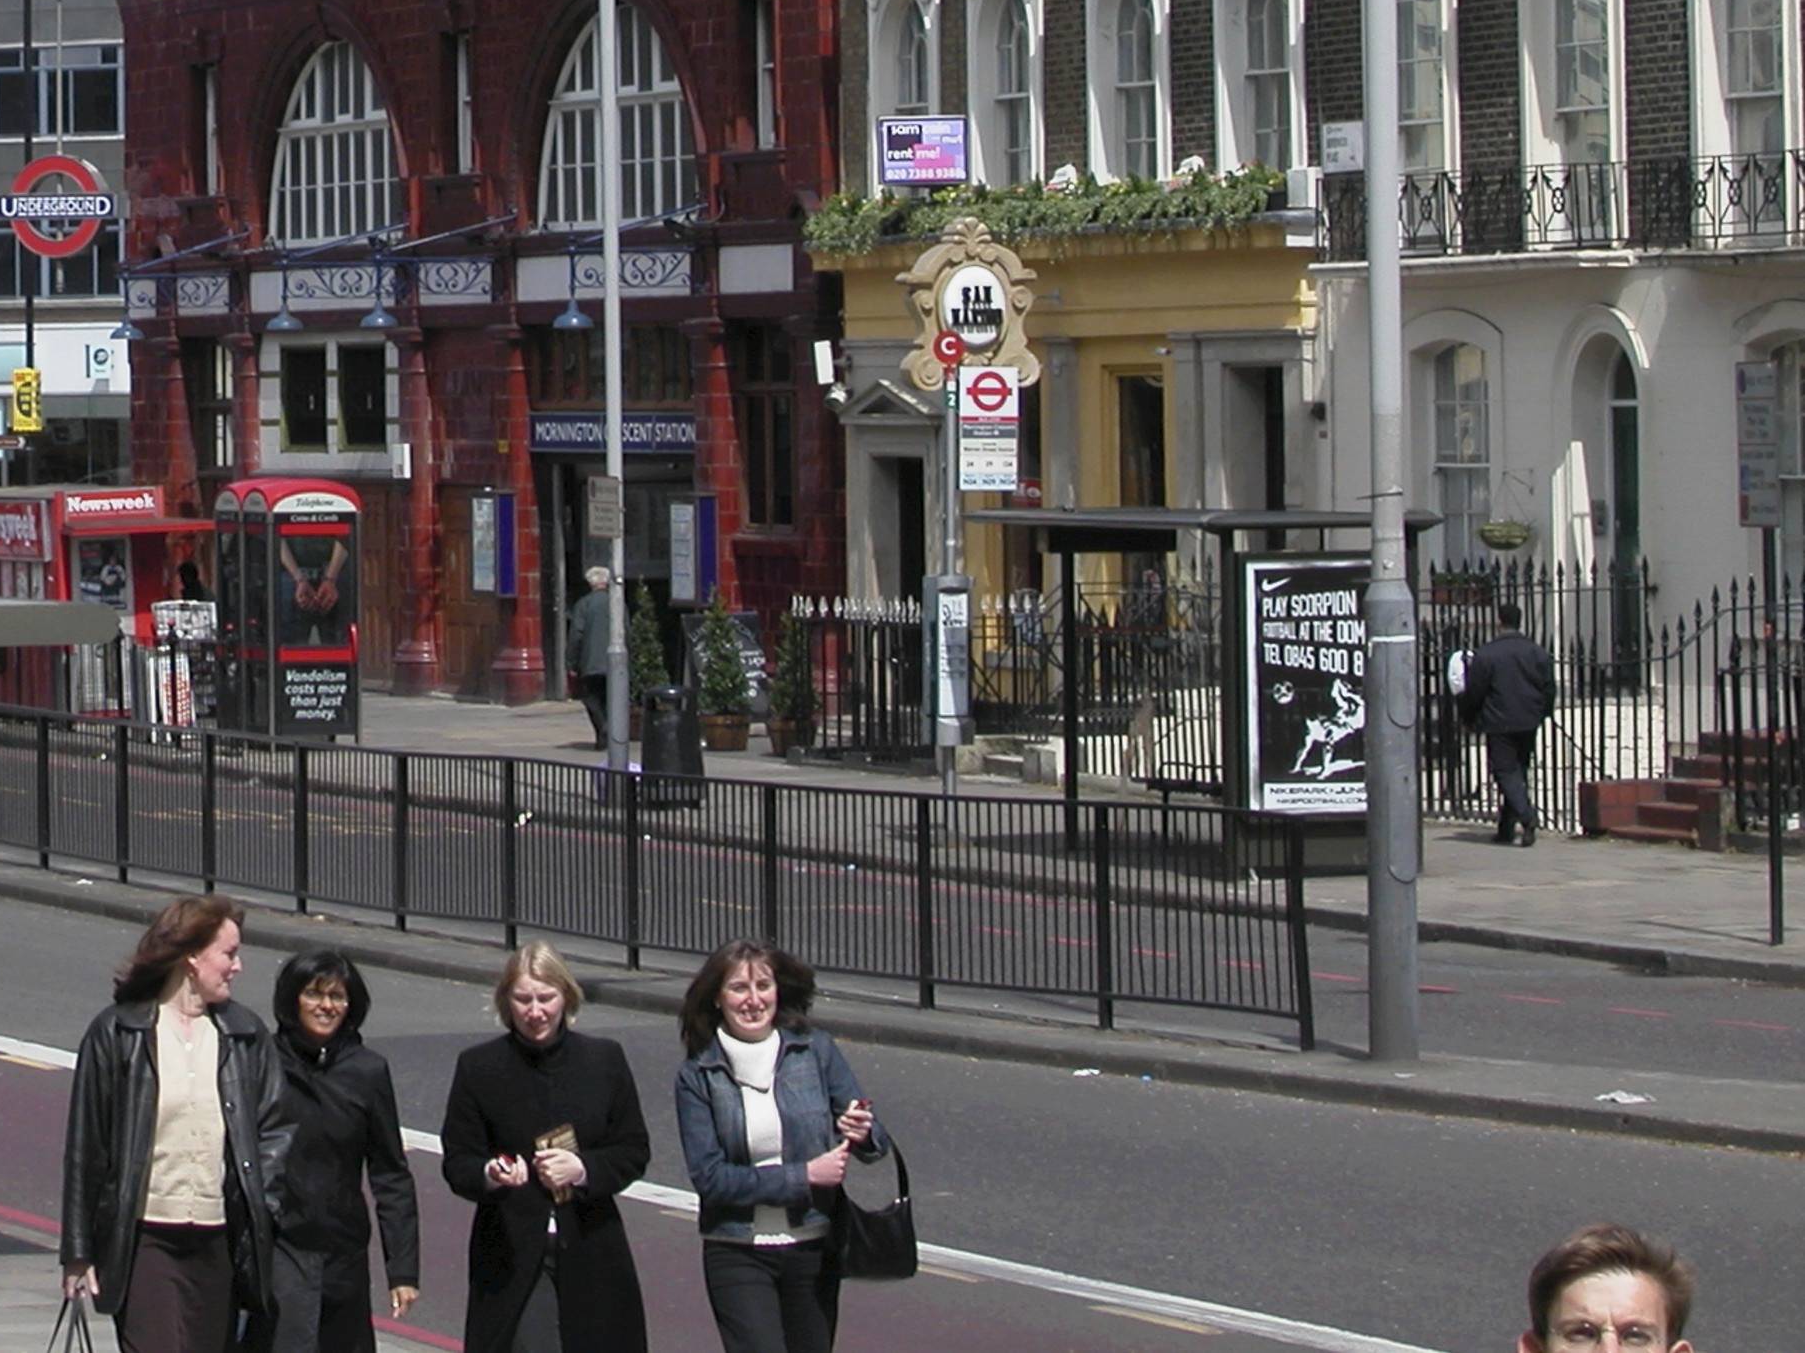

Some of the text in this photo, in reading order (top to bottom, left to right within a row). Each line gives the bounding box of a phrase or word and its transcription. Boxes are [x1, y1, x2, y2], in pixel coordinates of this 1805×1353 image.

[888, 147, 913, 160] rent
[1, 196, 111, 217] UNDERGROUND
[941, 337, 956, 356] C
[948, 393, 956, 407] 2
[536, 422, 602, 442] MORNINGTON
[655, 423, 695, 443] STATION
[67, 492, 155, 513] Newsweek
[1262, 589, 1357, 618] PLAY SCORPION
[1298, 621, 1310, 641] AT
[1312, 620, 1334, 642] THE
[1262, 642, 1282, 665] TEL
[1284, 644, 1315, 670] 0845
[1319, 647, 1349, 675] 600
[286, 669, 347, 682] Vandalism
[284, 683, 348, 695] costs more
[290, 694, 342, 709] than just
[295, 709, 337, 721] money.
